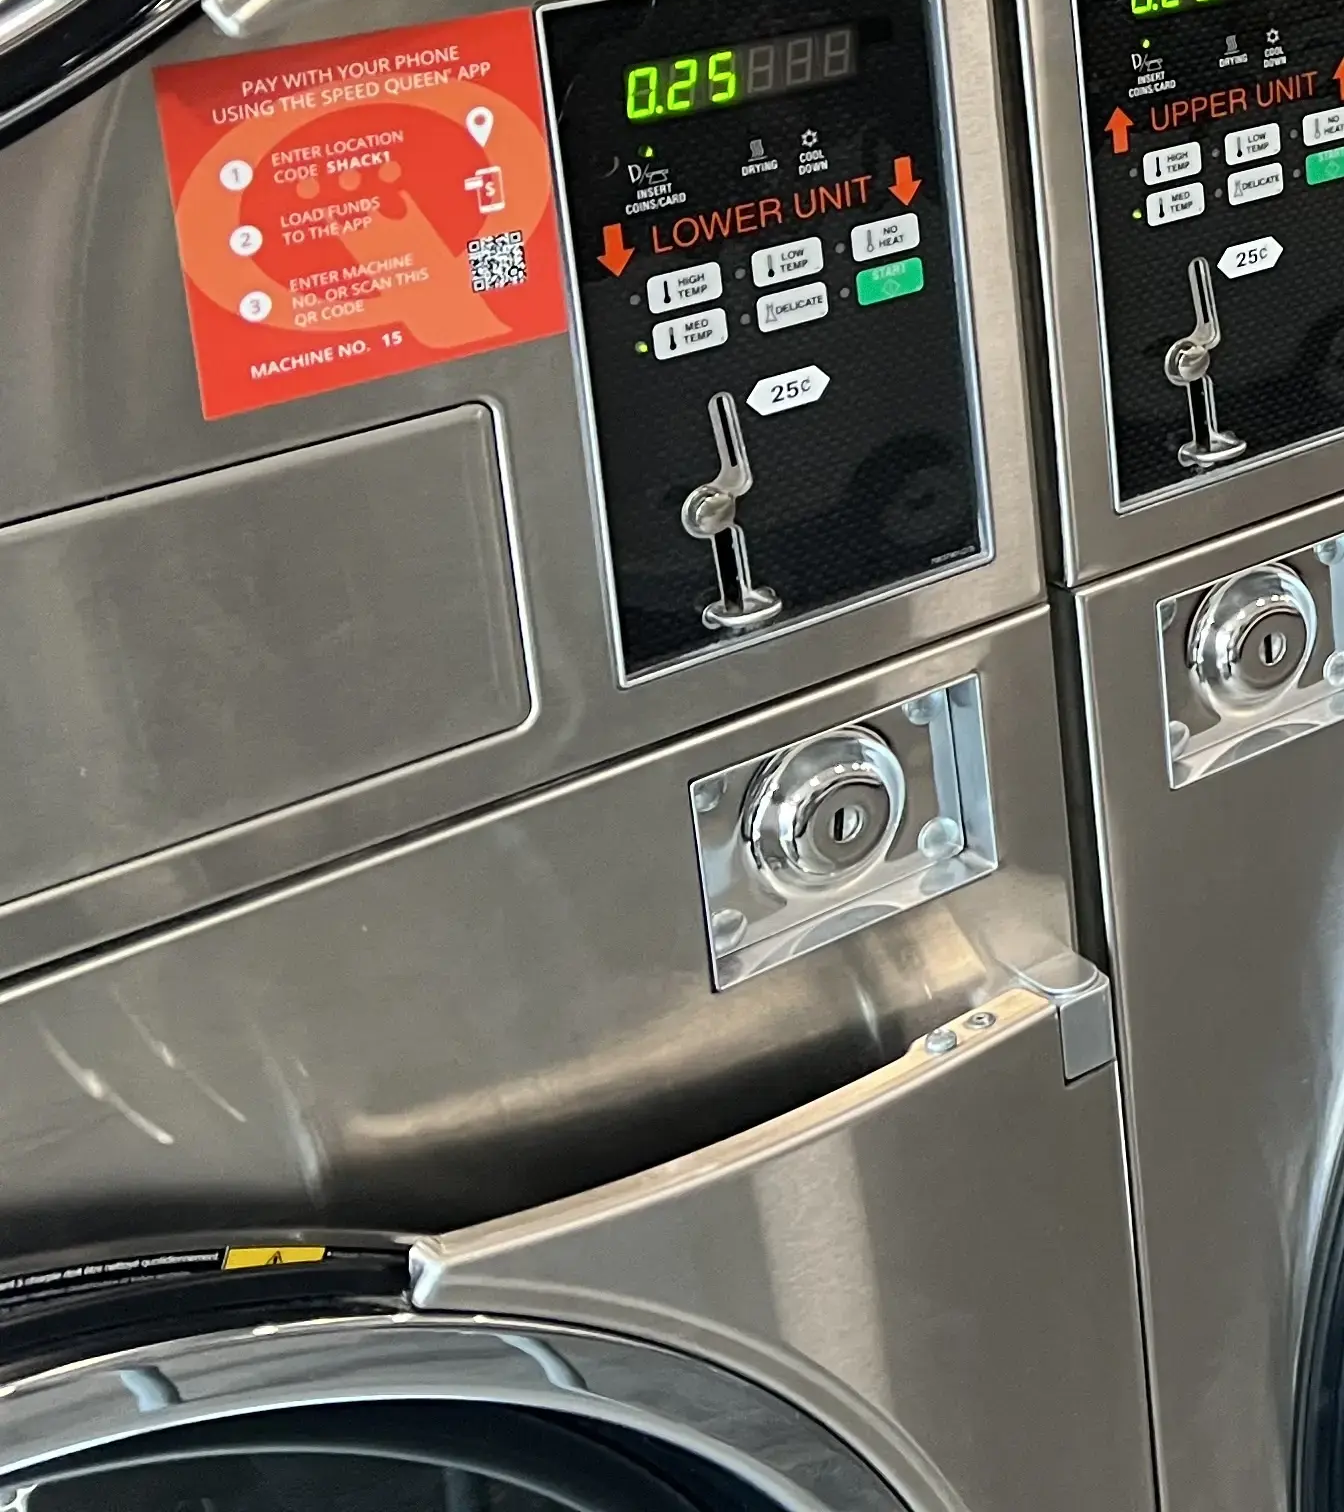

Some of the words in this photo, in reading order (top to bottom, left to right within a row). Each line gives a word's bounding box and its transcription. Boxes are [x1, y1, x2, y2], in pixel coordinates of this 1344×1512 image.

[242, 77, 277, 97] PAY
[282, 67, 332, 88] WITH
[337, 58, 390, 80] YOUR
[395, 45, 460, 70] PHONE
[627, 51, 736, 118] 0.25
[212, 99, 275, 125] USING
[279, 94, 316, 113] THE
[321, 82, 379, 105] SPEED
[457, 62, 491, 81] APP
[1151, 88, 1247, 131] UPPER
[1256, 71, 1318, 107] UNIT
[1328, 115, 1339, 124] NO
[1324, 124, 1344, 135] HEAT
[1248, 132, 1266, 144] LOW
[271, 142, 321, 167] ENTER
[325, 131, 404, 156] LOCATION
[1247, 142, 1269, 153] TEMP
[800, 150, 824, 162] COOL
[1168, 151, 1188, 162] HIGH
[273, 165, 318, 184] CODE
[327, 151, 390, 174] SHACK1
[742, 160, 778, 176] DRYING
[799, 160, 828, 175] DOWN
[1167, 161, 1190, 174] TEMP
[1242, 174, 1279, 190] DELICATE
[637, 183, 672, 199] INSERT
[1172, 192, 1190, 202] MED
[626, 192, 686, 214] COINS/CARD
[1170, 201, 1193, 214] TEMP
[280, 208, 323, 228] LOAD
[327, 196, 380, 217] FUNDS
[653, 198, 782, 253] LOWER
[794, 175, 872, 218] UNIT
[281, 232, 304, 246] TO
[310, 223, 339, 239] THE
[342, 217, 372, 232] APP
[883, 225, 898, 235] NO
[879, 235, 904, 247] HEAT
[780, 249, 804, 261] LOW
[290, 271, 338, 293] ENTER
[342, 253, 413, 279] MACHINE
[780, 260, 808, 272] TEMP
[871, 264, 906, 280] START
[678, 273, 705, 286] HIGH
[292, 293, 322, 310] NO.
[325, 287, 347, 302] OR
[352, 278, 392, 296] SCAN
[395, 268, 429, 285] THIS
[678, 285, 708, 299] TEMP
[776, 295, 823, 314] DELICATE
[294, 311, 317, 328] QR
[321, 300, 365, 320] CODE
[685, 319, 709, 331] MED
[684, 330, 712, 344] TEMP
[250, 347, 333, 379] MACHINE
[338, 340, 371, 358] NO.
[382, 332, 403, 347] 15
